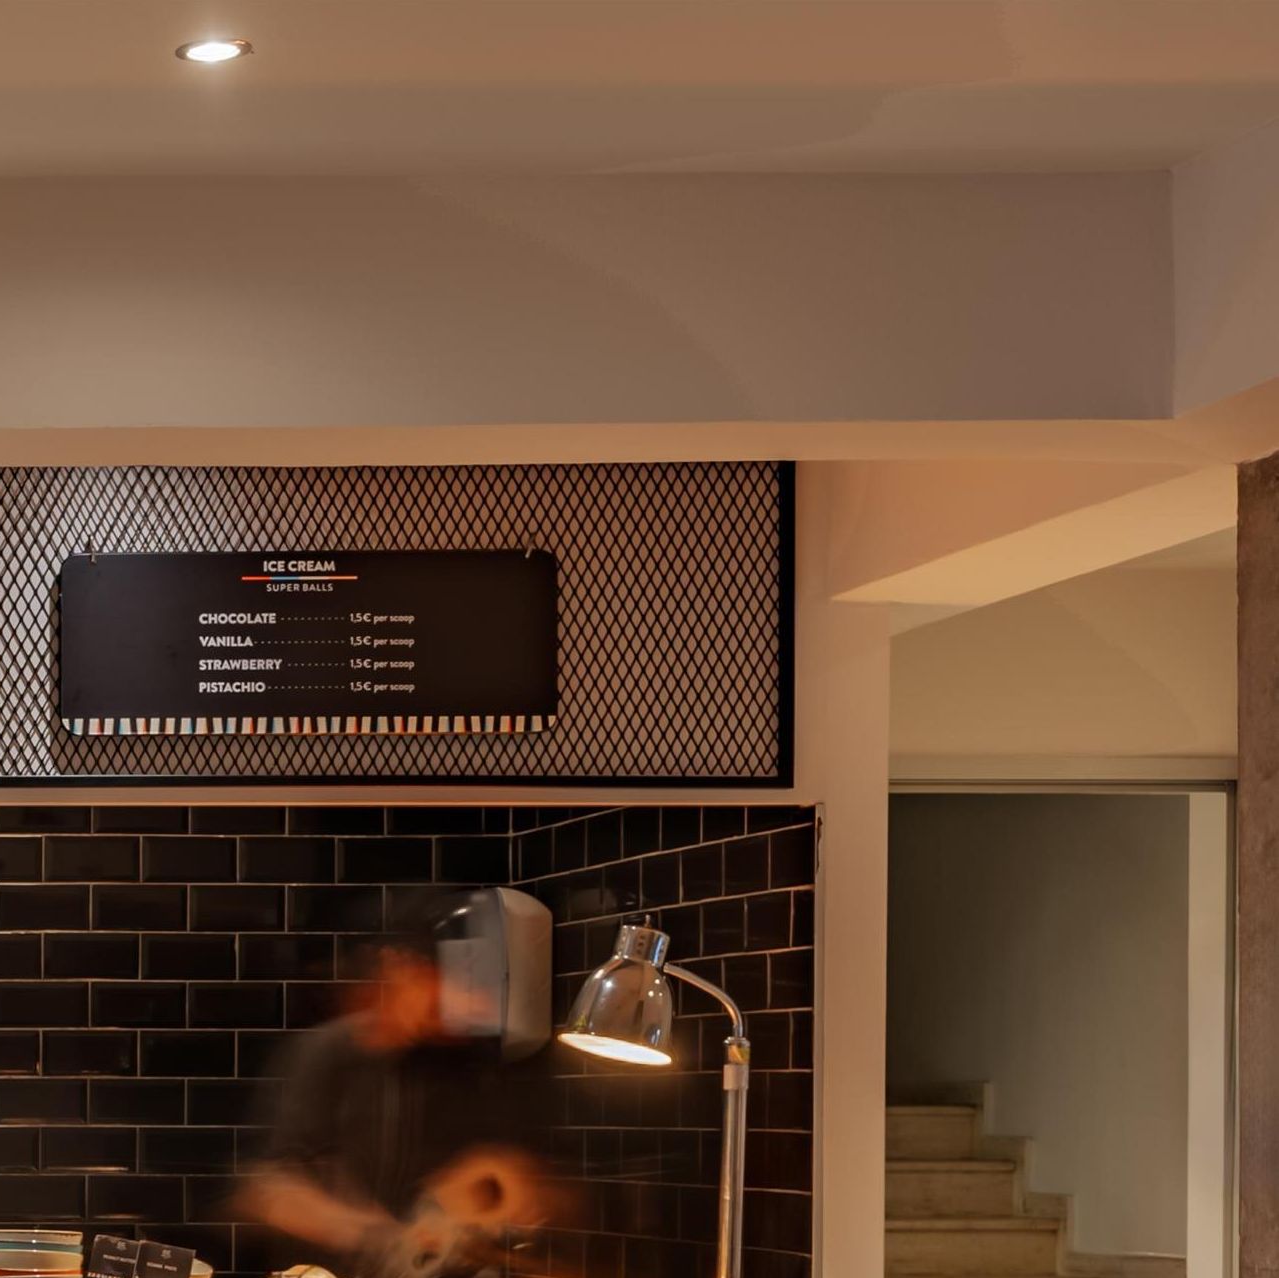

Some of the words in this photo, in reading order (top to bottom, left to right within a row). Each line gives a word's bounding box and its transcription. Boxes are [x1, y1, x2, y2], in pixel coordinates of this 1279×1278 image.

[263, 560, 286, 572] ICE
[287, 560, 336, 572] CREAM
[266, 583, 300, 592] SUPER
[302, 583, 334, 592] BALLS
[198, 613, 277, 625] CHOCOLATE
[350, 612, 372, 624] 1,5€
[373, 614, 388, 625] per
[390, 615, 415, 625] scoop
[198, 636, 254, 648] VANILLA
[350, 635, 372, 647] 1,5€
[373, 637, 388, 648] per
[390, 638, 415, 648] scoop
[198, 659, 283, 671] STRAWBERRY
[350, 658, 372, 670] 1,5€
[373, 660, 388, 671] per
[390, 661, 415, 671] scoop
[198, 681, 266, 694] PISTACHIO
[350, 681, 372, 693] 1,5€
[373, 683, 388, 694] per
[390, 684, 415, 694] scoop
